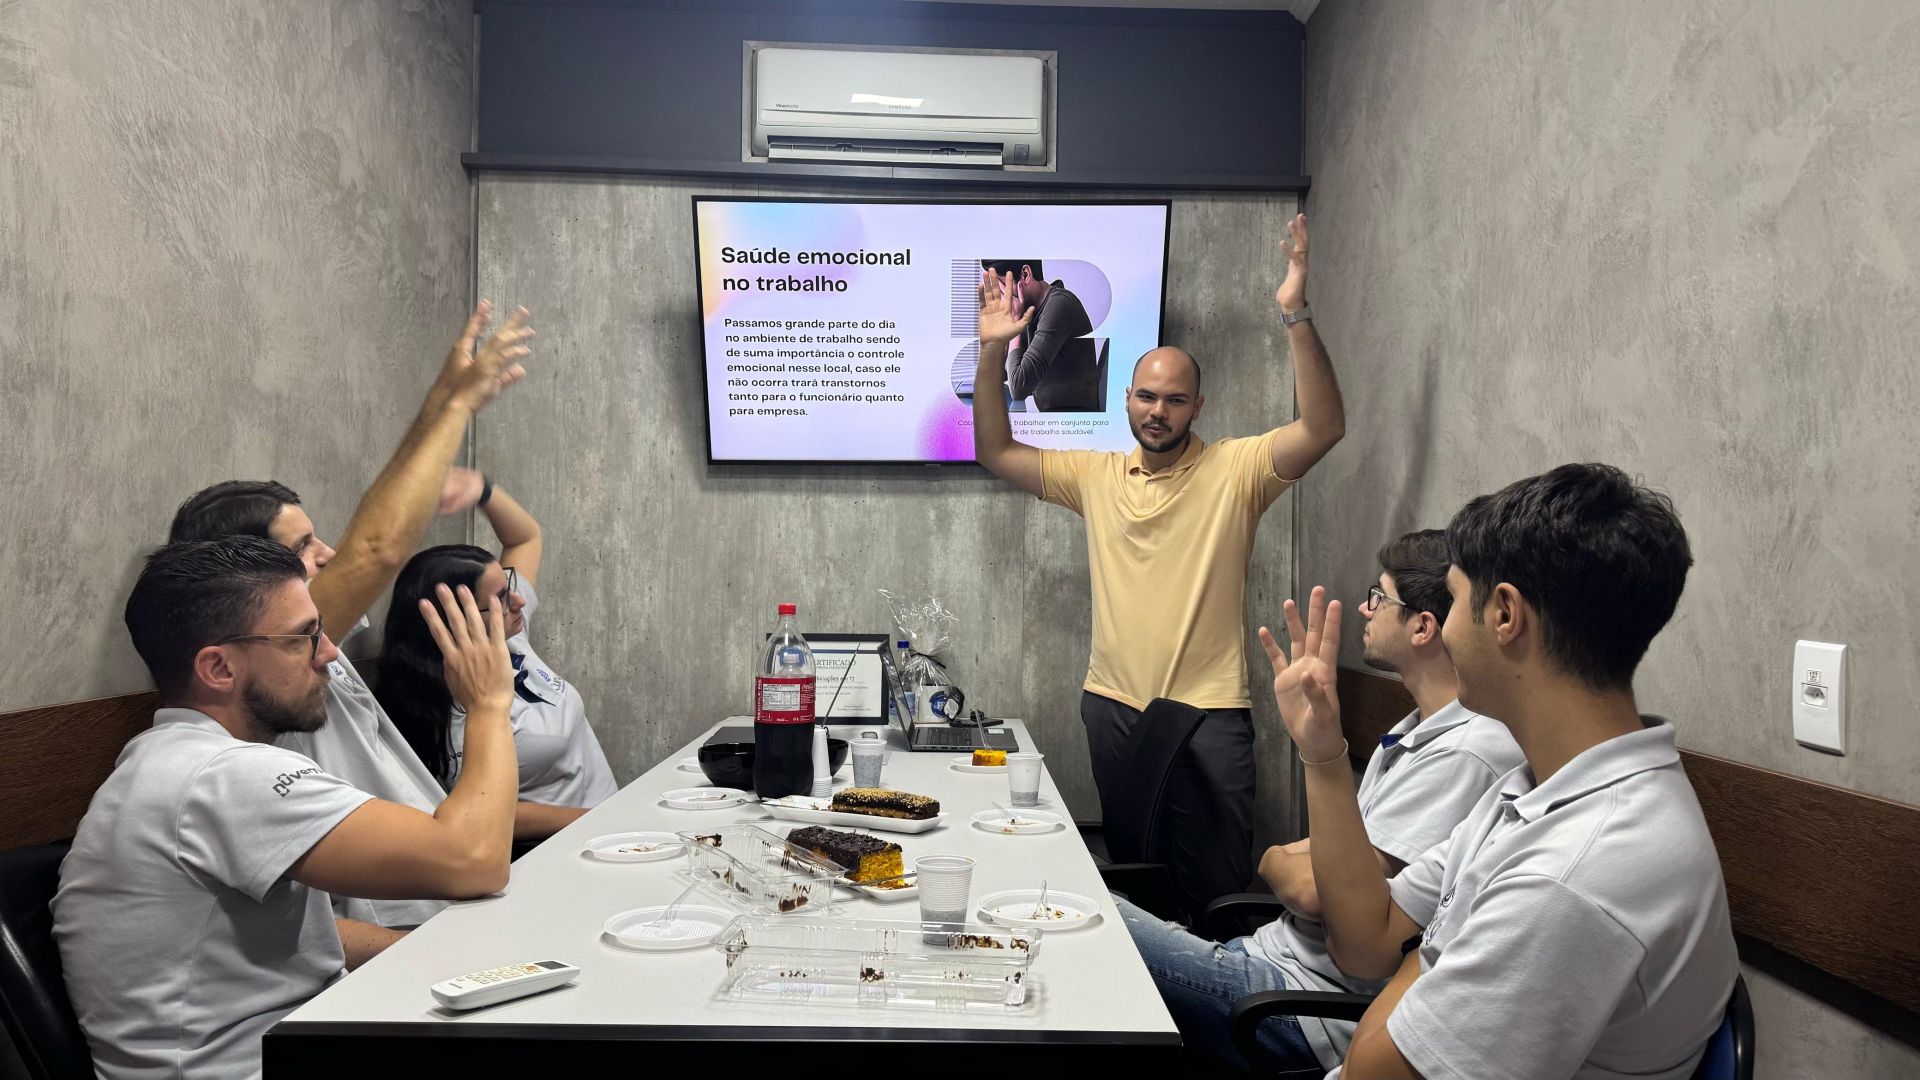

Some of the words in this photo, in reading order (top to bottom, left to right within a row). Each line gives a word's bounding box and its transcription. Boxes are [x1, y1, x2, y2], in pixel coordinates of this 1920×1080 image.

[721, 247, 791, 264] Saúde
[797, 249, 911, 266] emocional
[723, 277, 750, 291] no
[756, 275, 848, 292] trabalho
[724, 318, 782, 328] Passamos
[785, 319, 825, 330] grande
[828, 320, 858, 330] parte
[861, 320, 876, 329] do
[878, 320, 896, 329] dia
[725, 335, 740, 343] no
[743, 334, 796, 343] ambiente
[799, 334, 814, 343] de
[816, 335, 863, 344] trabalho
[866, 335, 901, 344] sendo
[726, 348, 740, 357] de
[777, 348, 845, 359] importância
[857, 350, 905, 359] controle
[727, 363, 785, 372] emocional
[788, 364, 821, 372] nesse
[824, 364, 853, 374] local,
[855, 365, 881, 373] caso
[884, 364, 901, 373] ele
[727, 378, 749, 387] não
[751, 379, 788, 387] ocorra
[791, 378, 818, 387] trará
[821, 379, 886, 388] transtornos
[729, 392, 759, 401] tanto
[761, 393, 786, 402] para
[799, 392, 863, 402] funcionário
[865, 393, 905, 403] quanto
[729, 407, 754, 417] para
[757, 408, 808, 417] empresa.
[1060, 419, 1091, 427] conjunto
